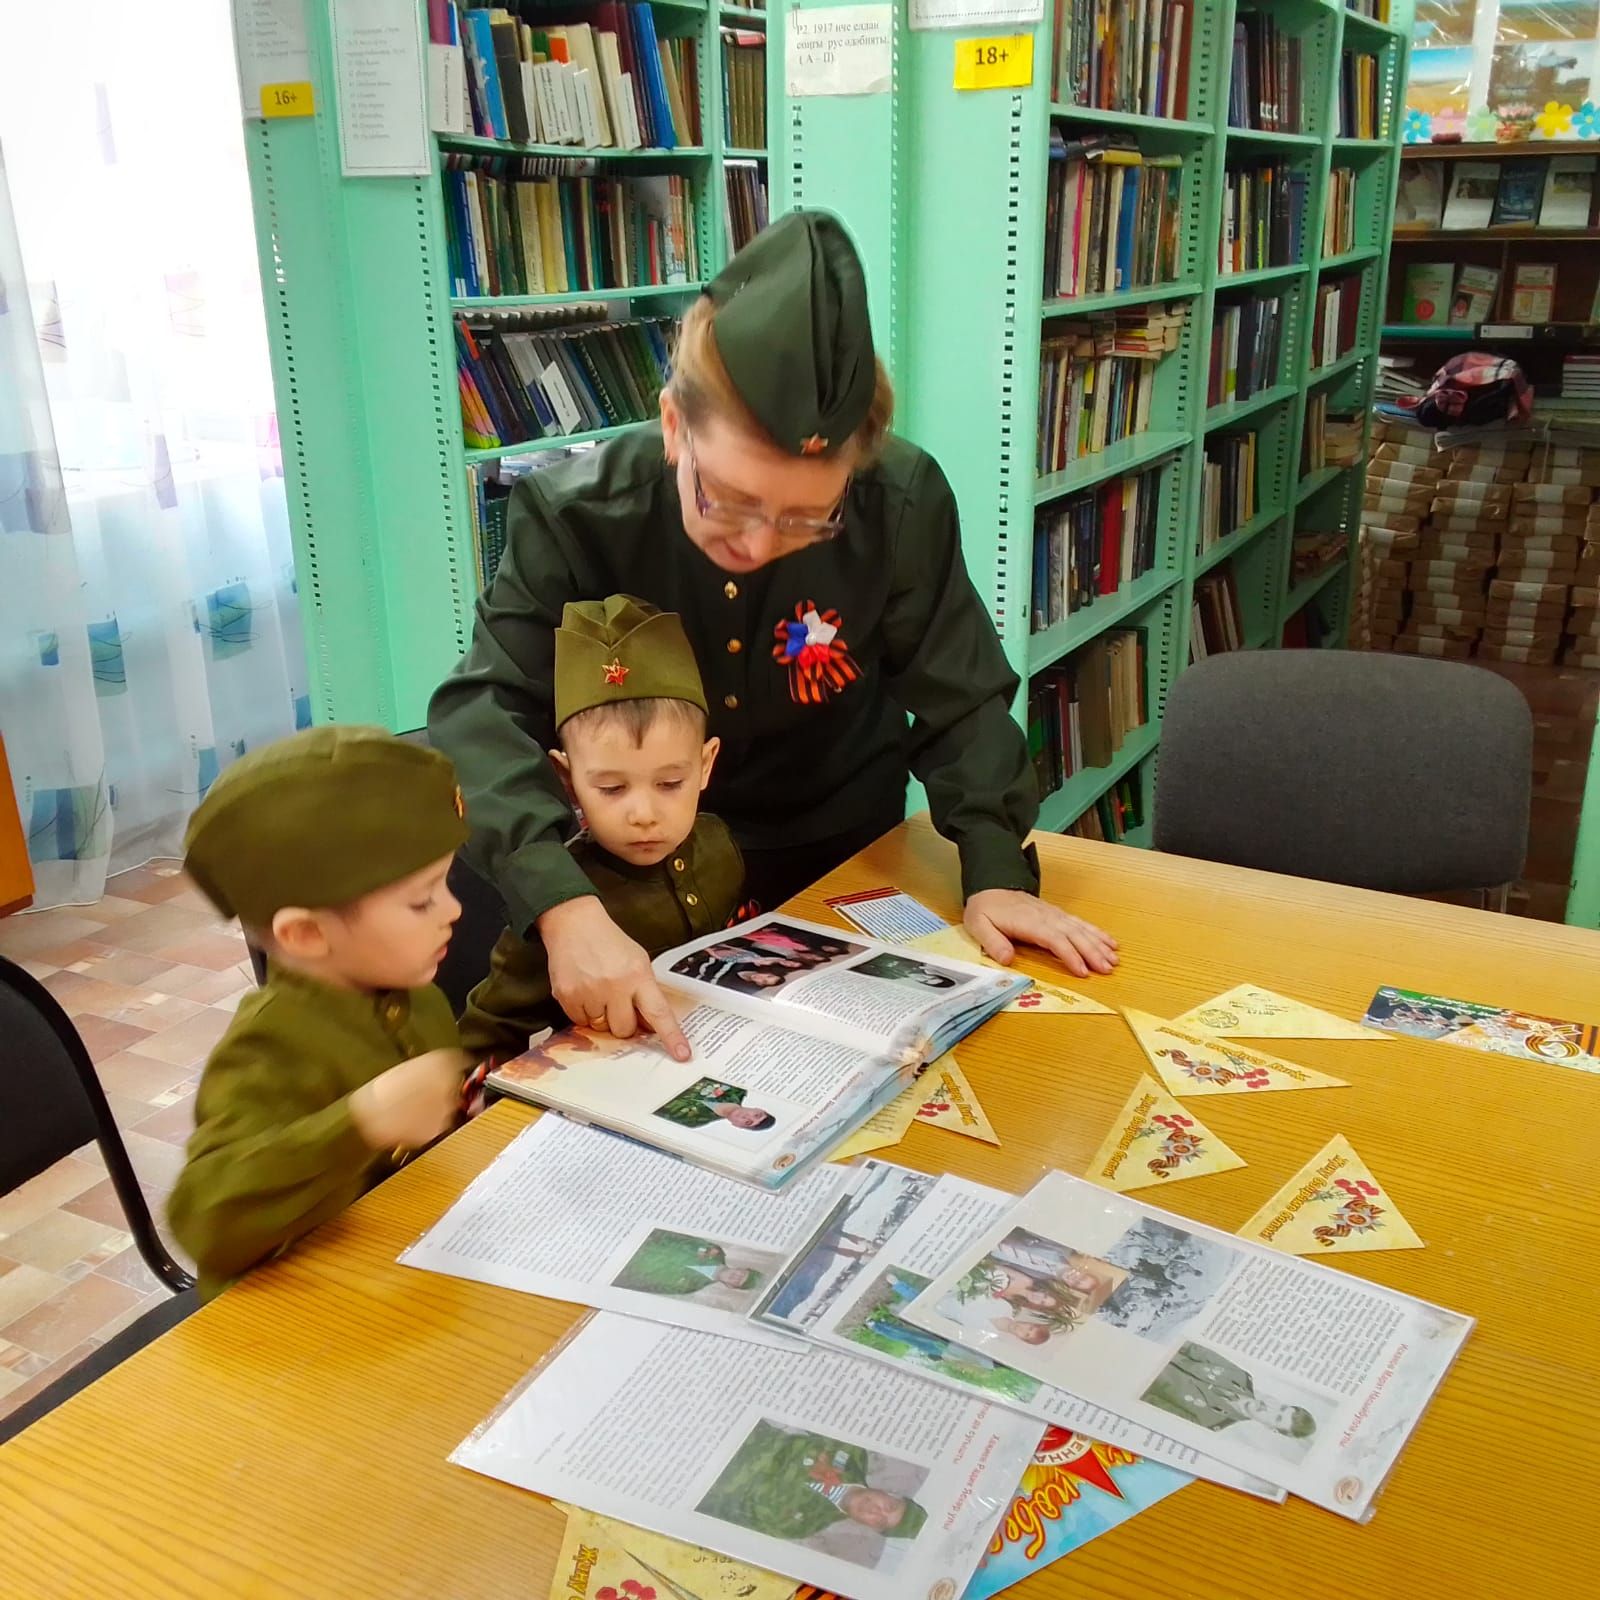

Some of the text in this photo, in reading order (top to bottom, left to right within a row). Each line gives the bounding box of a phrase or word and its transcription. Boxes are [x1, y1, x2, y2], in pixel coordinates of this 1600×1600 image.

[813, 23, 833, 34] 1917
[827, 39, 843, 50] рус
[975, 46, 1009, 66] 18+
[274, 90, 298, 106] 16+
